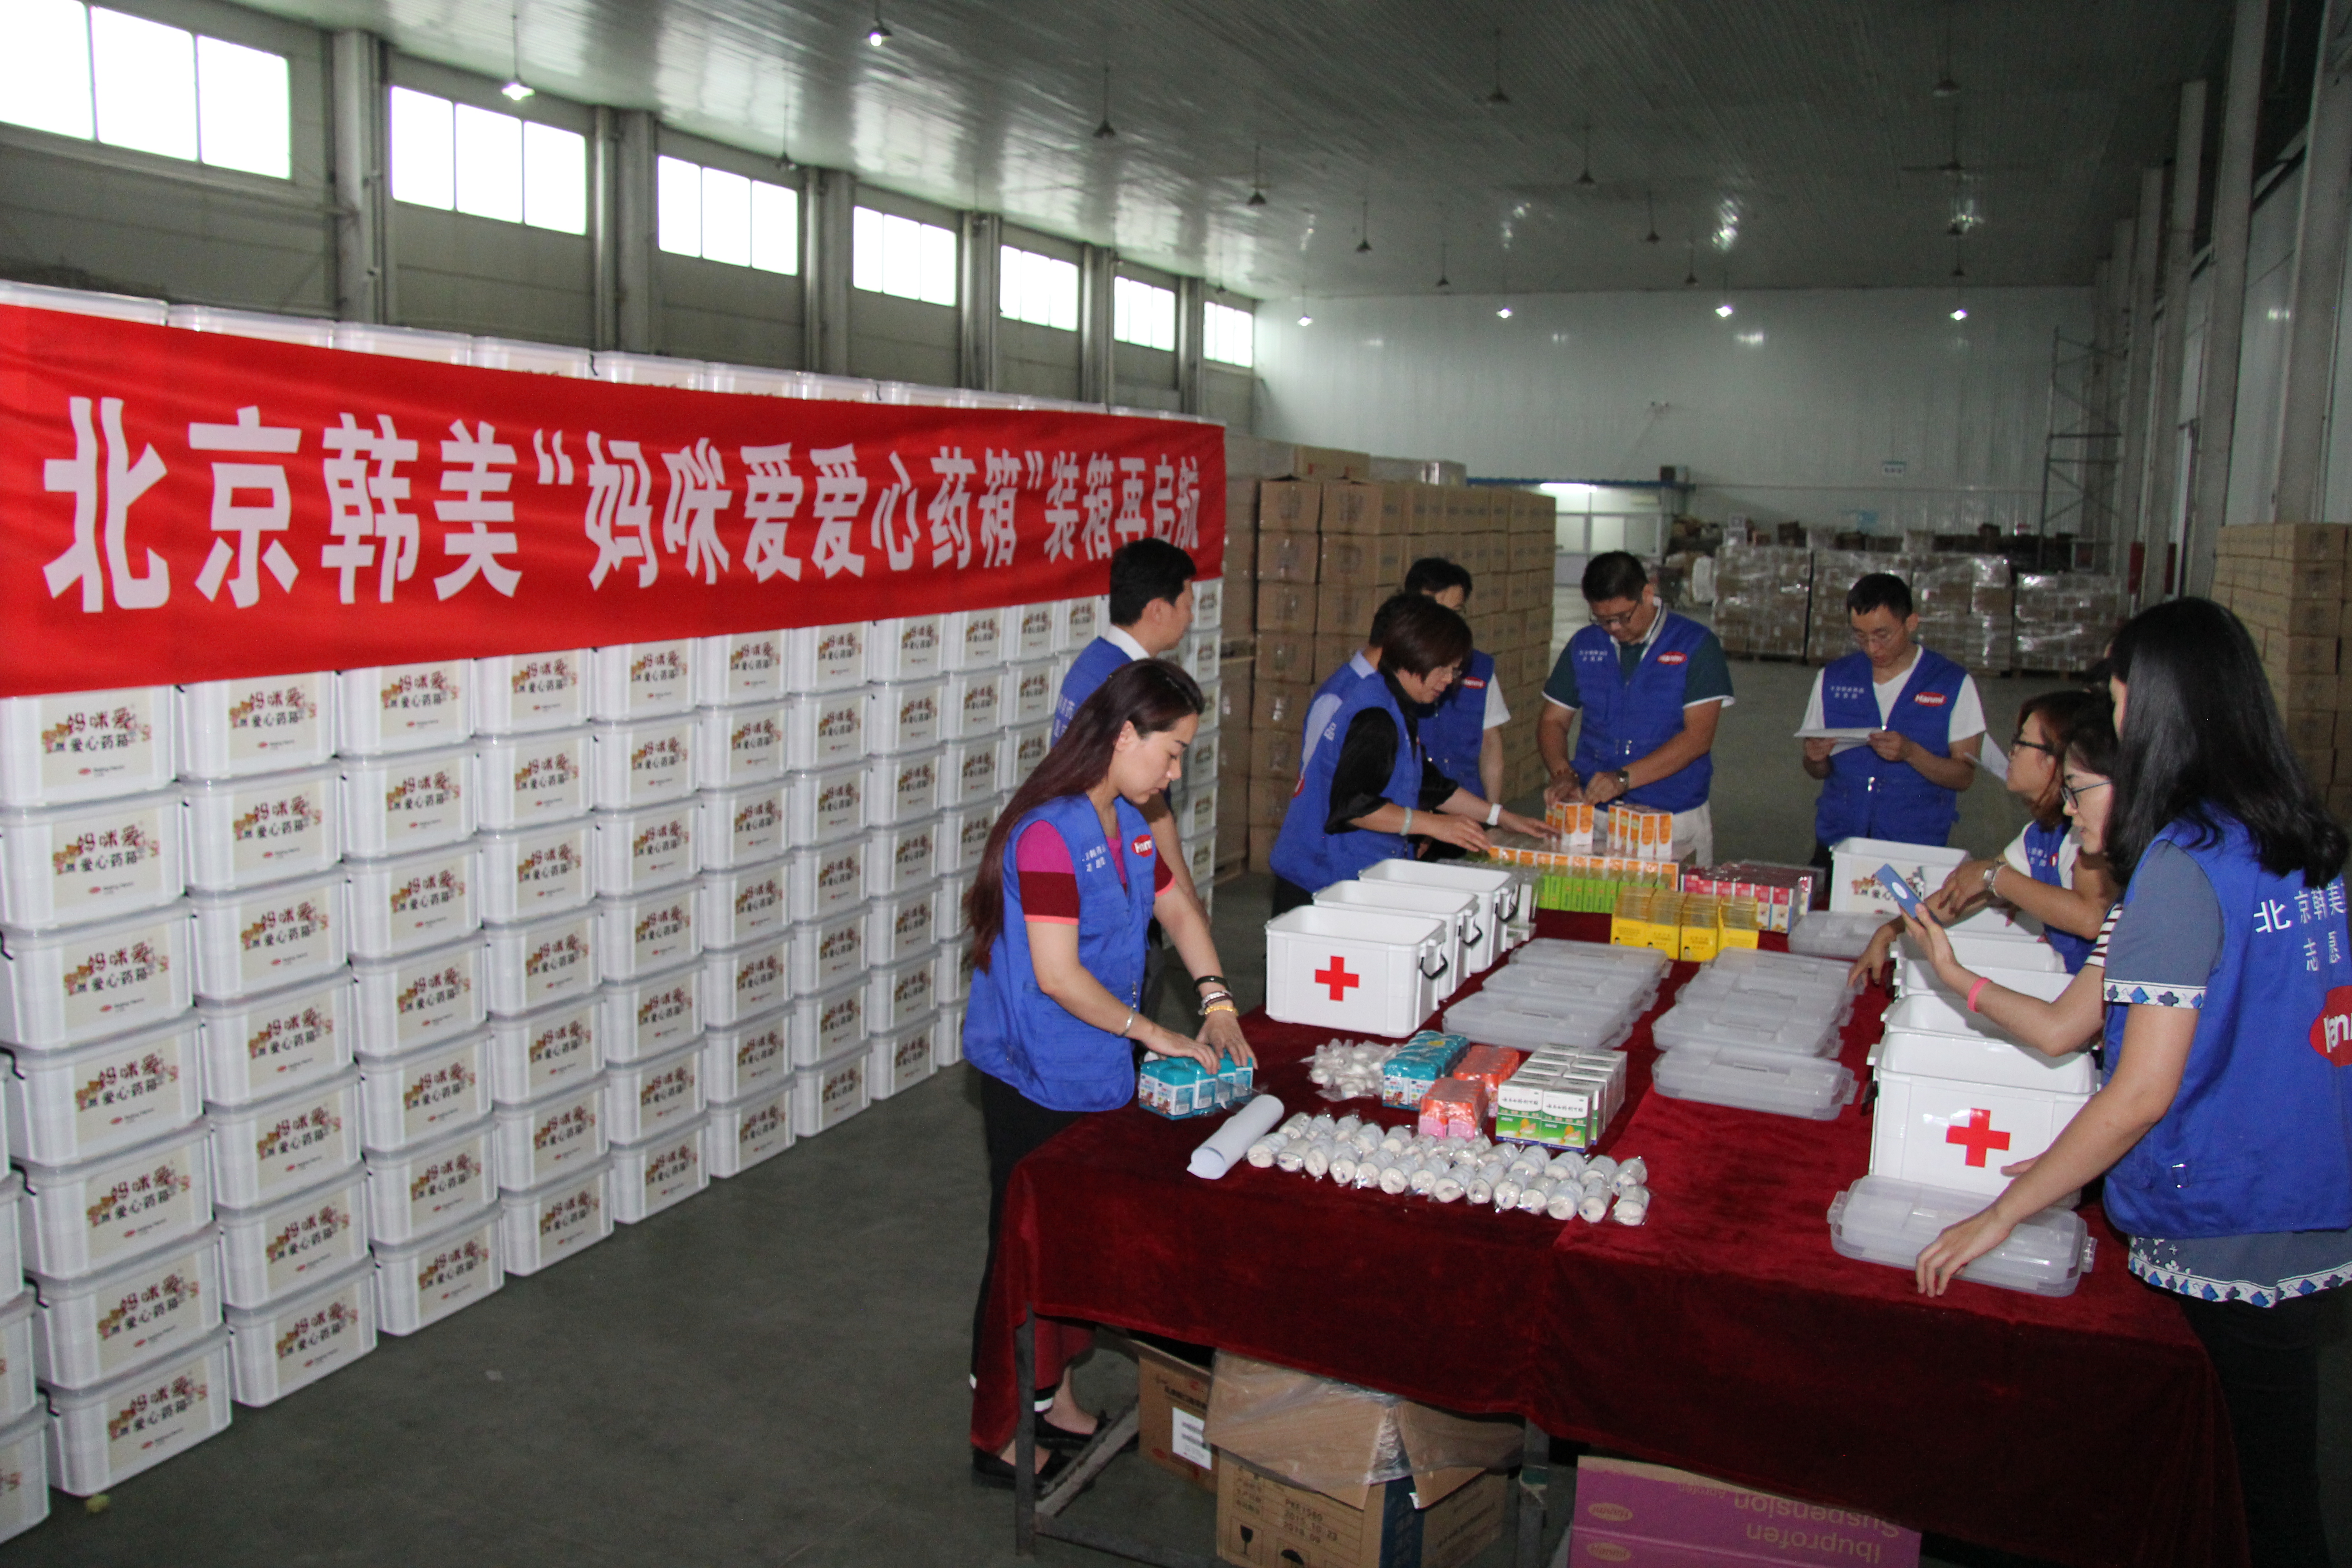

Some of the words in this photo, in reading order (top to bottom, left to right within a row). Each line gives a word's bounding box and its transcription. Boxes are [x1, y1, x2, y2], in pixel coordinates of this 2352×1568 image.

[44, 396, 1200, 612] 北京韩美“妈咪爱爱心药箱”装箱再启航
[67, 707, 132, 735] 妈咪爱
[70, 734, 128, 752] 爱心药箱
[78, 824, 141, 856] 妈咪爱
[81, 850, 137, 872] 爱心药箱
[2253, 880, 2347, 933] 北京韩美
[88, 941, 150, 975] 妈咪爱
[92, 967, 147, 991] 爱心药箱
[99, 1053, 160, 1089] 妈咪爱
[103, 1078, 157, 1105] 爱心药箱
[112, 1165, 172, 1203] 妈咪爱
[115, 1189, 169, 1219] 爱心药箱
[121, 1274, 180, 1315] 妈咪爱
[125, 1296, 178, 1330] 爱心药箱
[131, 1376, 189, 1416] 妈咪爱
[134, 1398, 186, 1431] 爱心药箱
[1746, 1523, 1881, 1564] Ibuprofen
